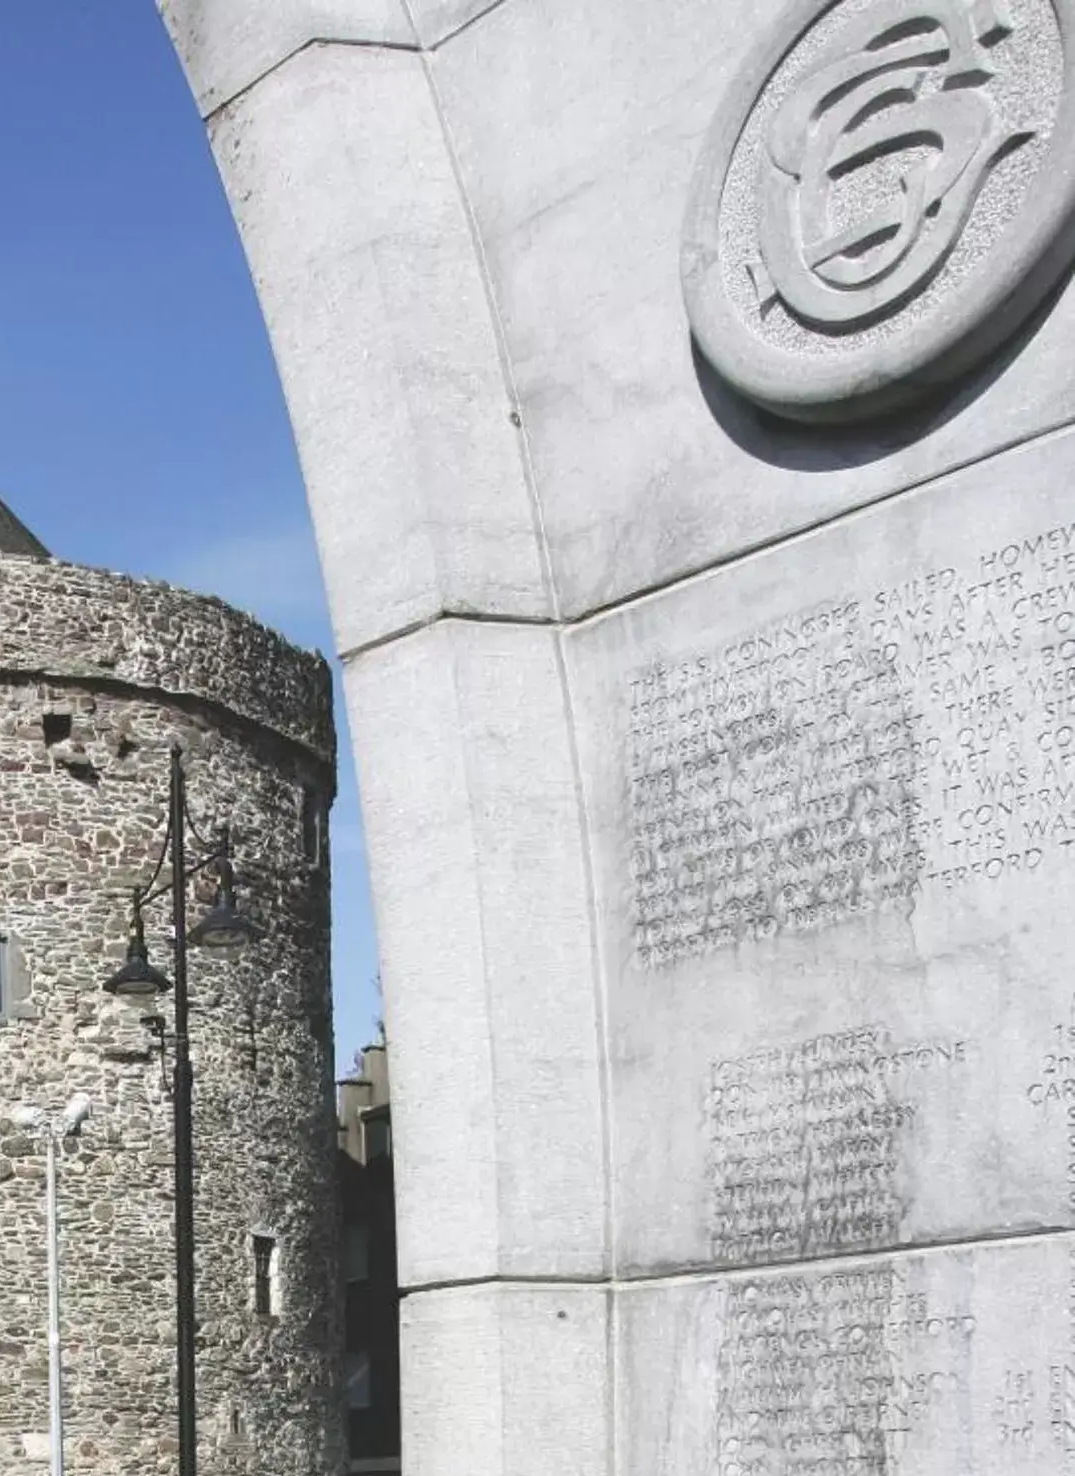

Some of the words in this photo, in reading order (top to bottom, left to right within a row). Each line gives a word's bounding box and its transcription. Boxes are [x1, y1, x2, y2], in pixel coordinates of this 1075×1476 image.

[870, 601, 933, 641] DAYS
[948, 569, 1024, 614] AFTER
[873, 565, 956, 612] SAILED
[819, 641, 898, 684] BOARD
[912, 618, 966, 653] WAS
[980, 607, 997, 630] A
[965, 626, 1023, 663] WAS
[929, 663, 996, 702] SAME
[945, 685, 1013, 724] THERE
[942, 748, 990, 779] WET
[975, 766, 1028, 797] WAS
[948, 828, 1005, 860] THIS
[881, 846, 1044, 905] WATERFORD
